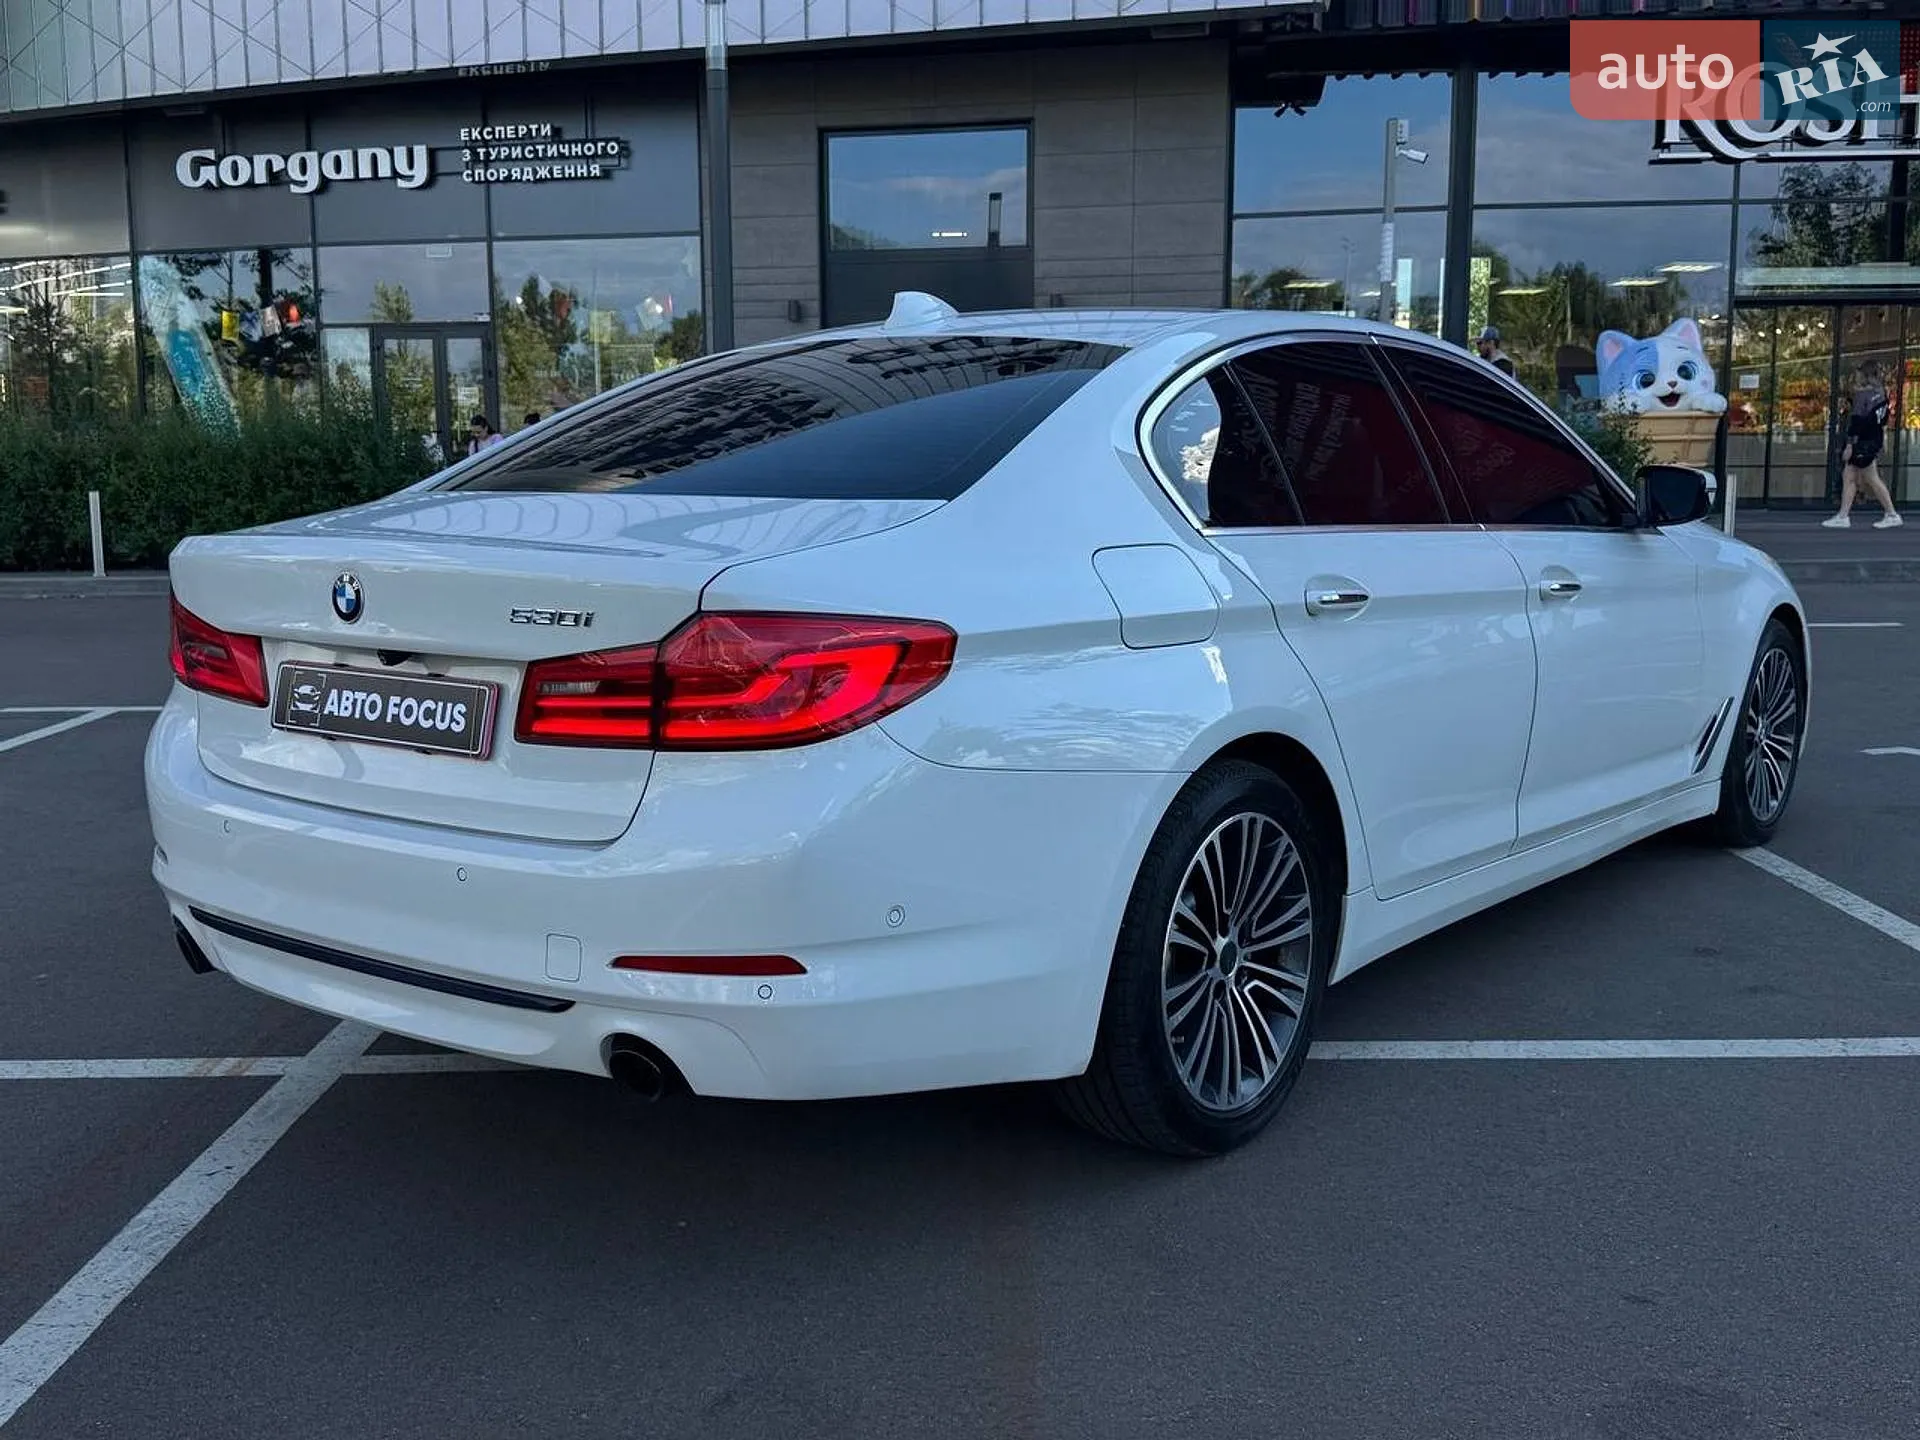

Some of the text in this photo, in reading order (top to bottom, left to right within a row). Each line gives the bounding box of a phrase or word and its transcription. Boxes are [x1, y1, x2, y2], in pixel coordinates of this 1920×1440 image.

[460, 123, 552, 141] ЕКСПЕРТИ
[476, 142, 619, 161] ТУРИСТИЧНОГО
[175, 144, 429, 194] Gorgany
[462, 164, 601, 182] СПОРЯДЖЕННЯ
[509, 607, 595, 628] 530i
[386, 696, 467, 733] FOCUS
